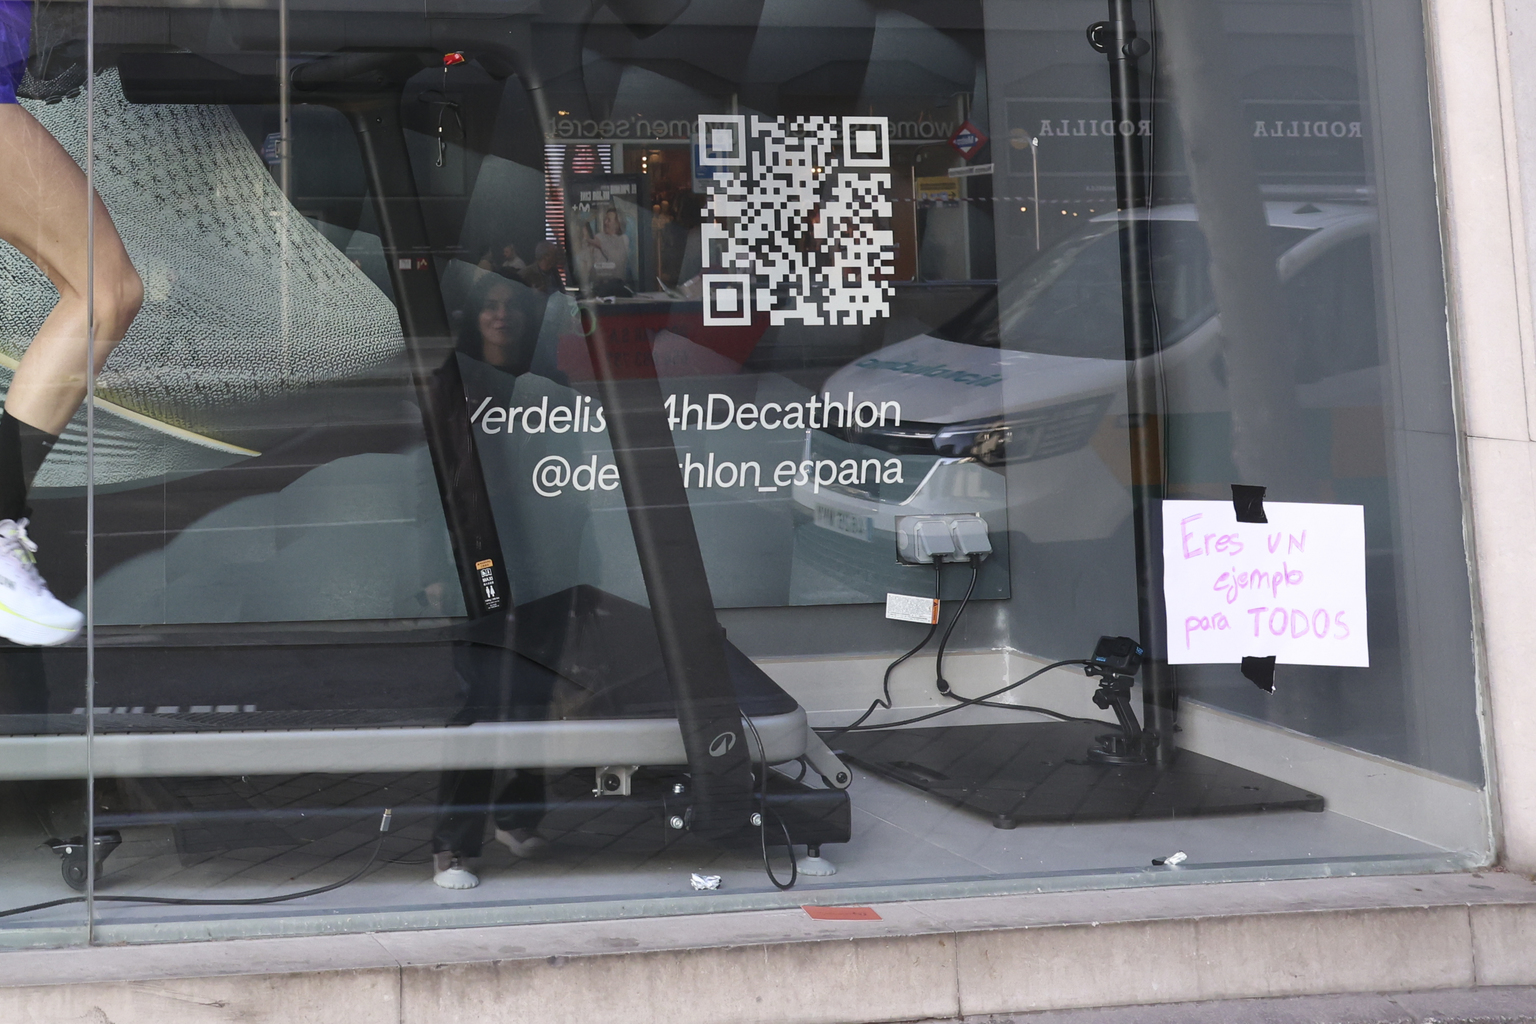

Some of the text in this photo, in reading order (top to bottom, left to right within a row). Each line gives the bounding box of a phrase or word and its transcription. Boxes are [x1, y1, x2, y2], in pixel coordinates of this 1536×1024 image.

[532, 453, 904, 497] @dehlon_espana
[1180, 513, 1244, 559] Eres
[1213, 561, 1304, 604] ejemplo
[1185, 607, 1350, 650] para TODOS
